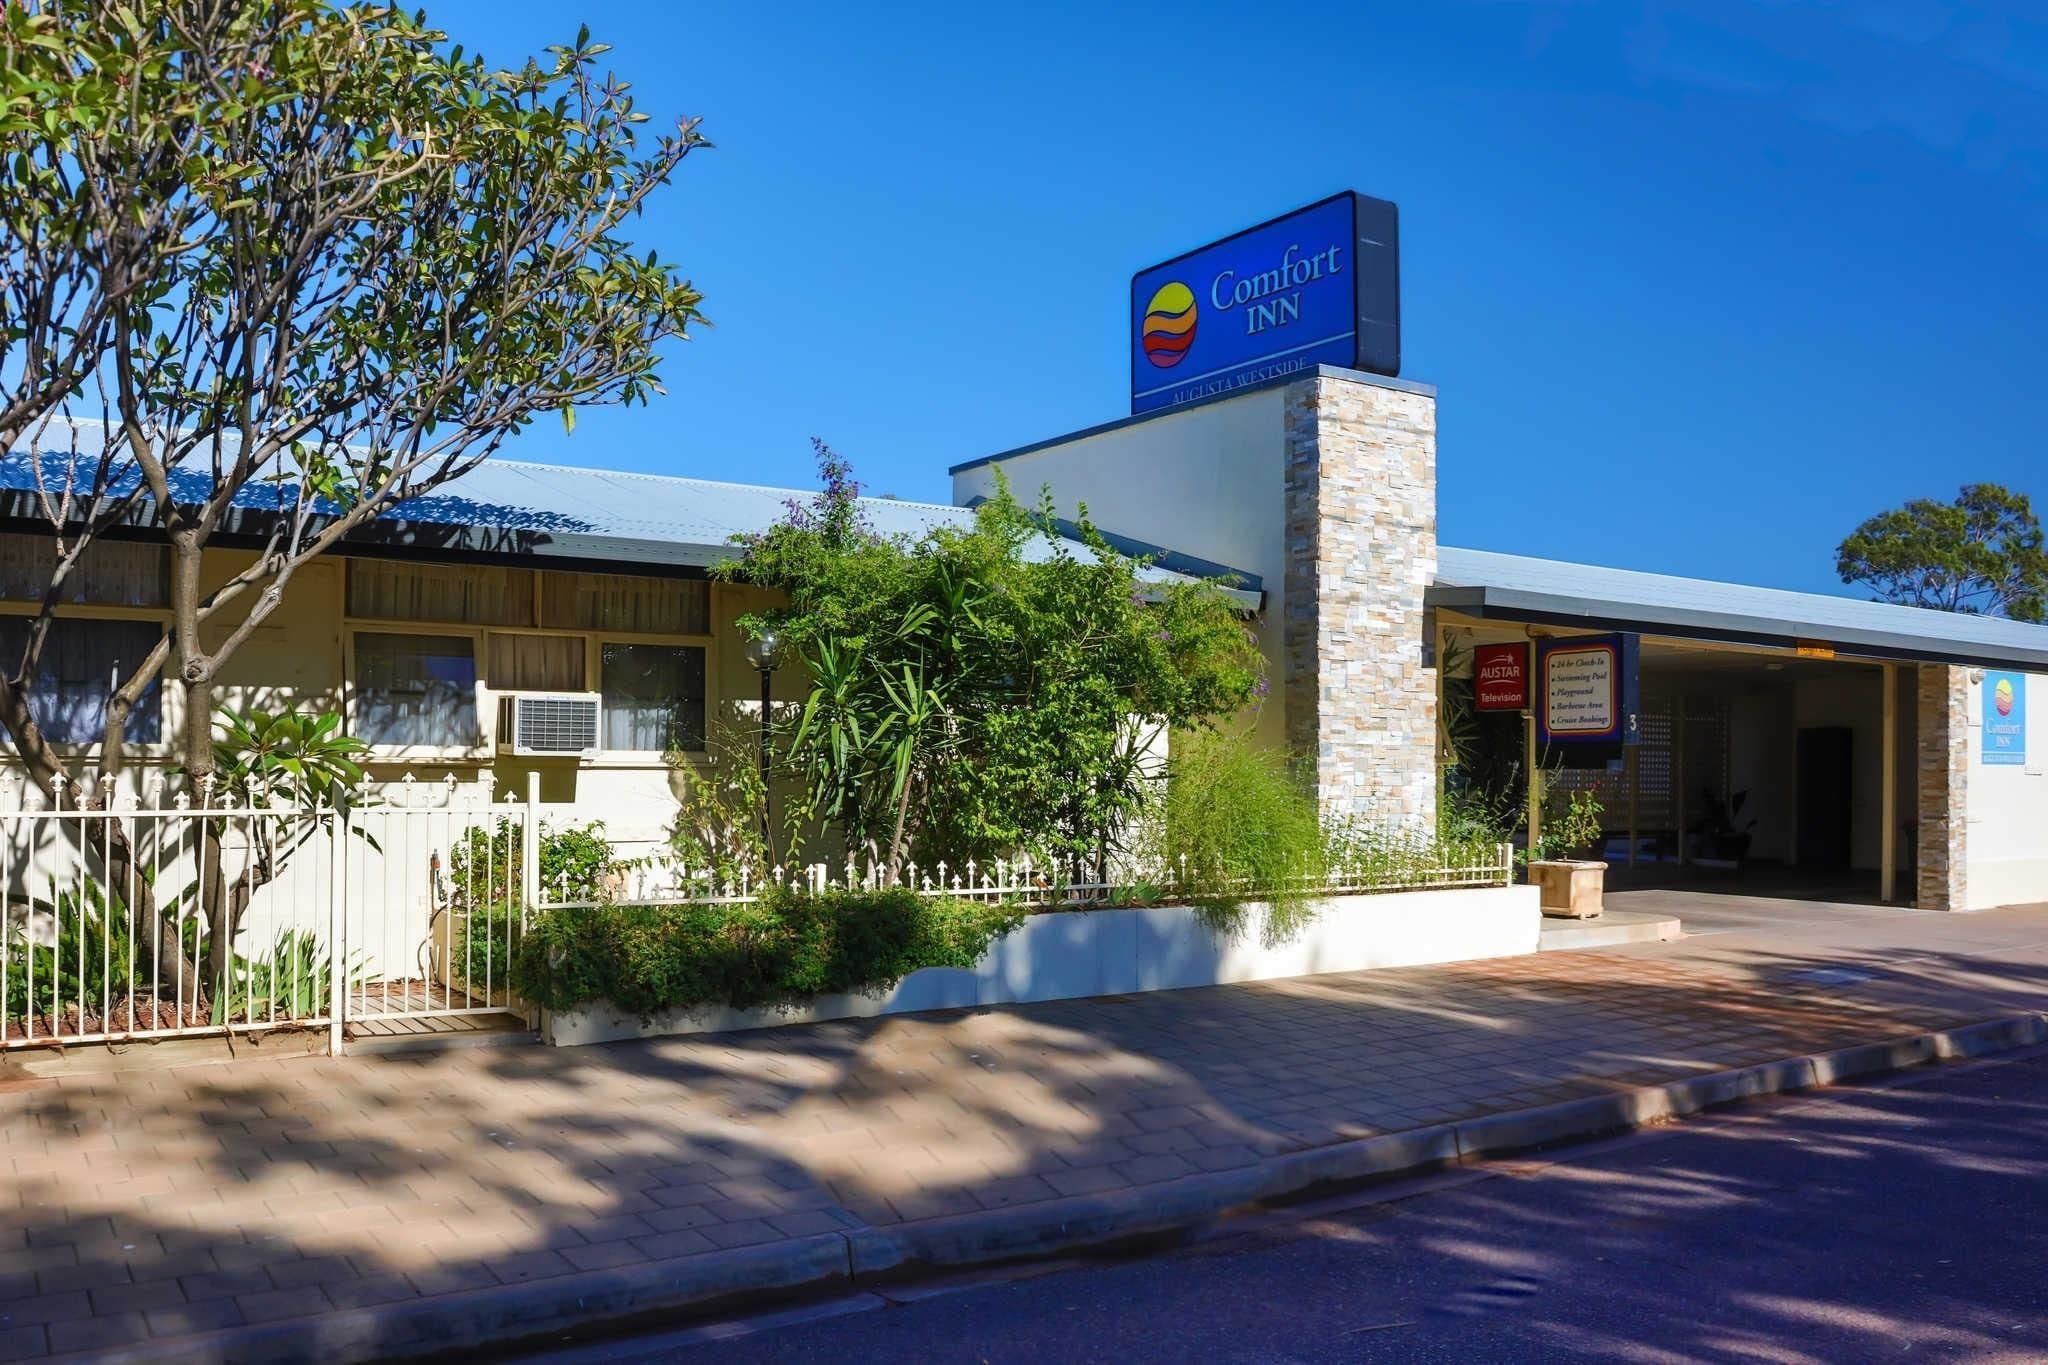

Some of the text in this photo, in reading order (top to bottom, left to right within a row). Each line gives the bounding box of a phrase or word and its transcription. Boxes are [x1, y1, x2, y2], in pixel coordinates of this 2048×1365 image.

[1211, 245, 1343, 310] Comfort
[1247, 292, 1301, 335] INN
[1172, 357, 1307, 403] AUGUSTA WESTSIDE
[1480, 666, 1520, 680] AUSTAR
[1556, 672, 1608, 683] Swimming Pool
[1480, 693, 1522, 703] Television
[1556, 687, 1594, 698] Playground
[1556, 702, 1586, 710] Barbecue
[1629, 714, 1637, 731] 3
